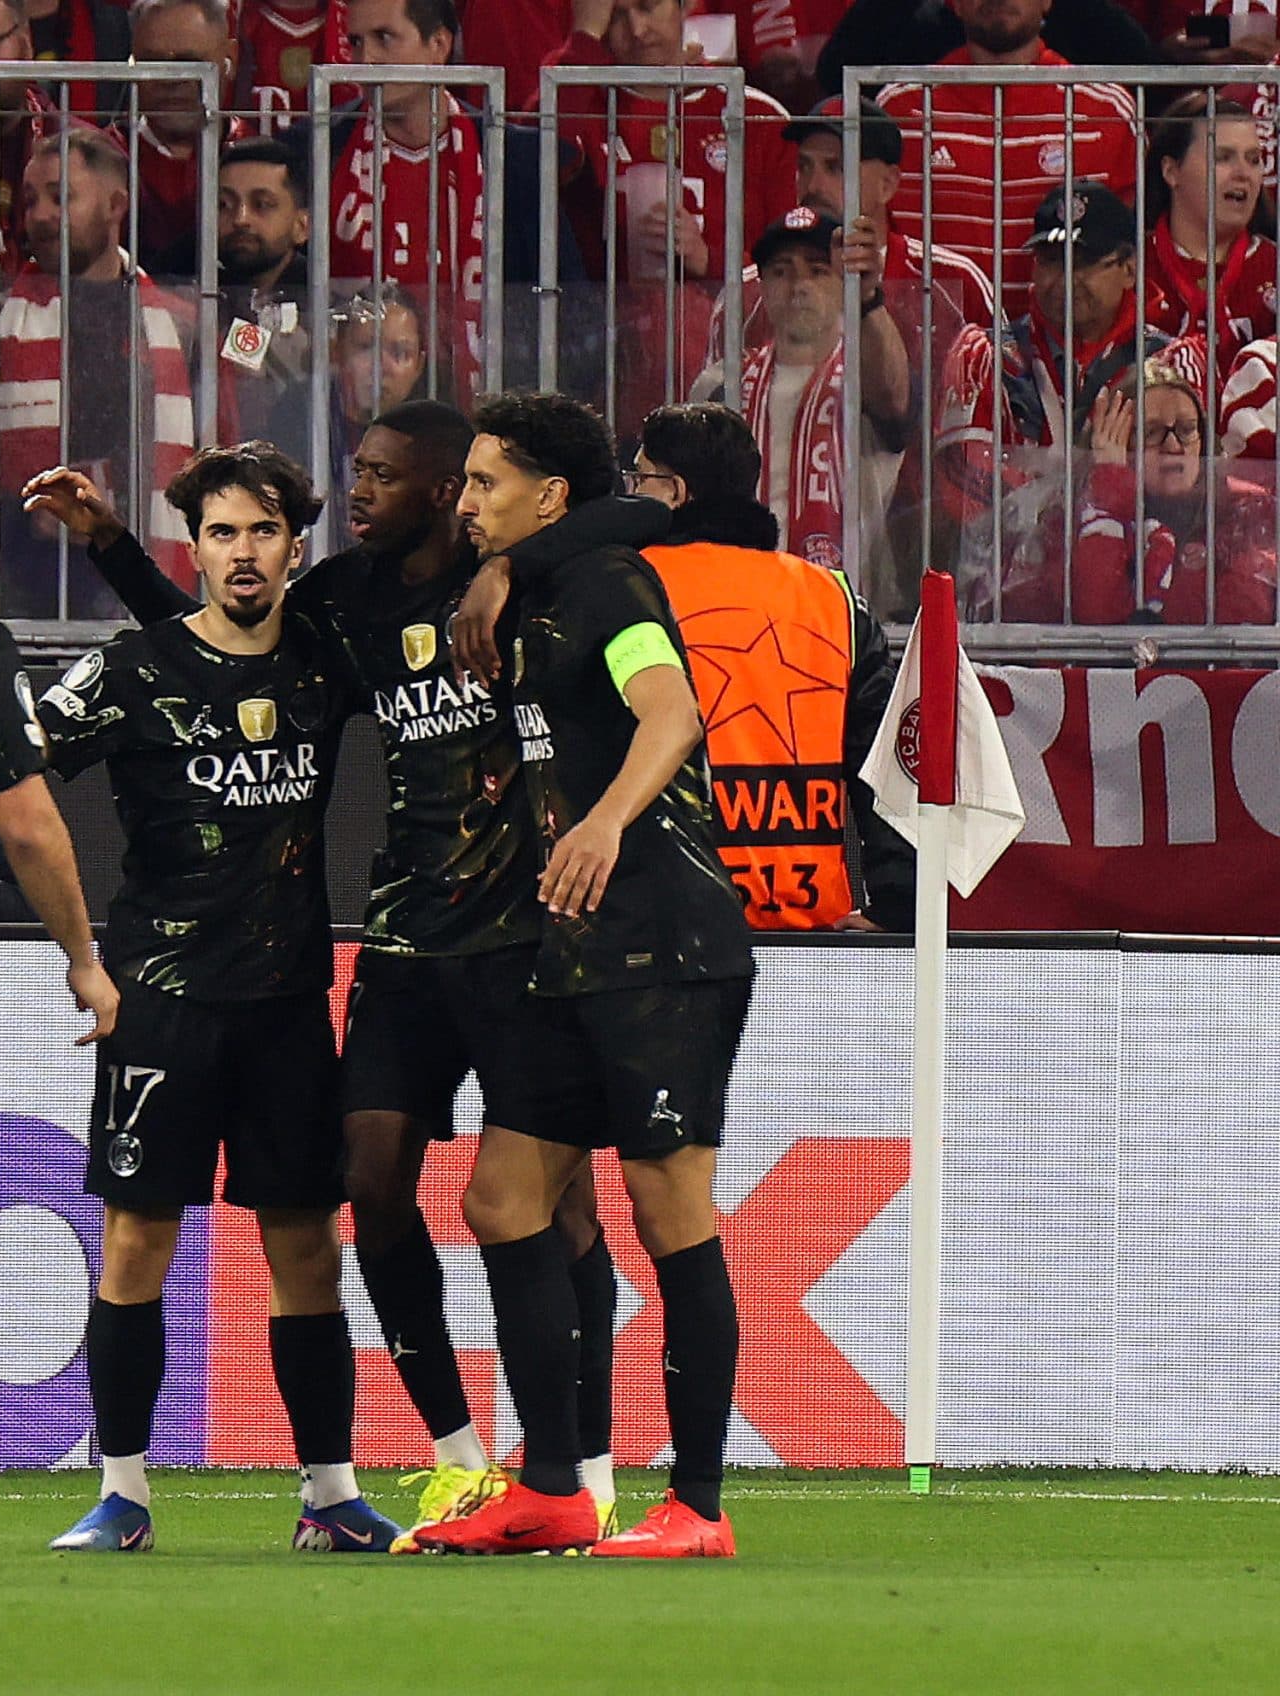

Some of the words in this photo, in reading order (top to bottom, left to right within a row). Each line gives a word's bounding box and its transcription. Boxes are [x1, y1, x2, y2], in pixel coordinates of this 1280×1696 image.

[375, 670, 492, 728] QATAR
[400, 702, 497, 743] AIRWAYS
[187, 744, 319, 792] QATAR
[712, 779, 847, 831] WAR
[724, 863, 820, 912] 513
[105, 1065, 166, 1131] 17
